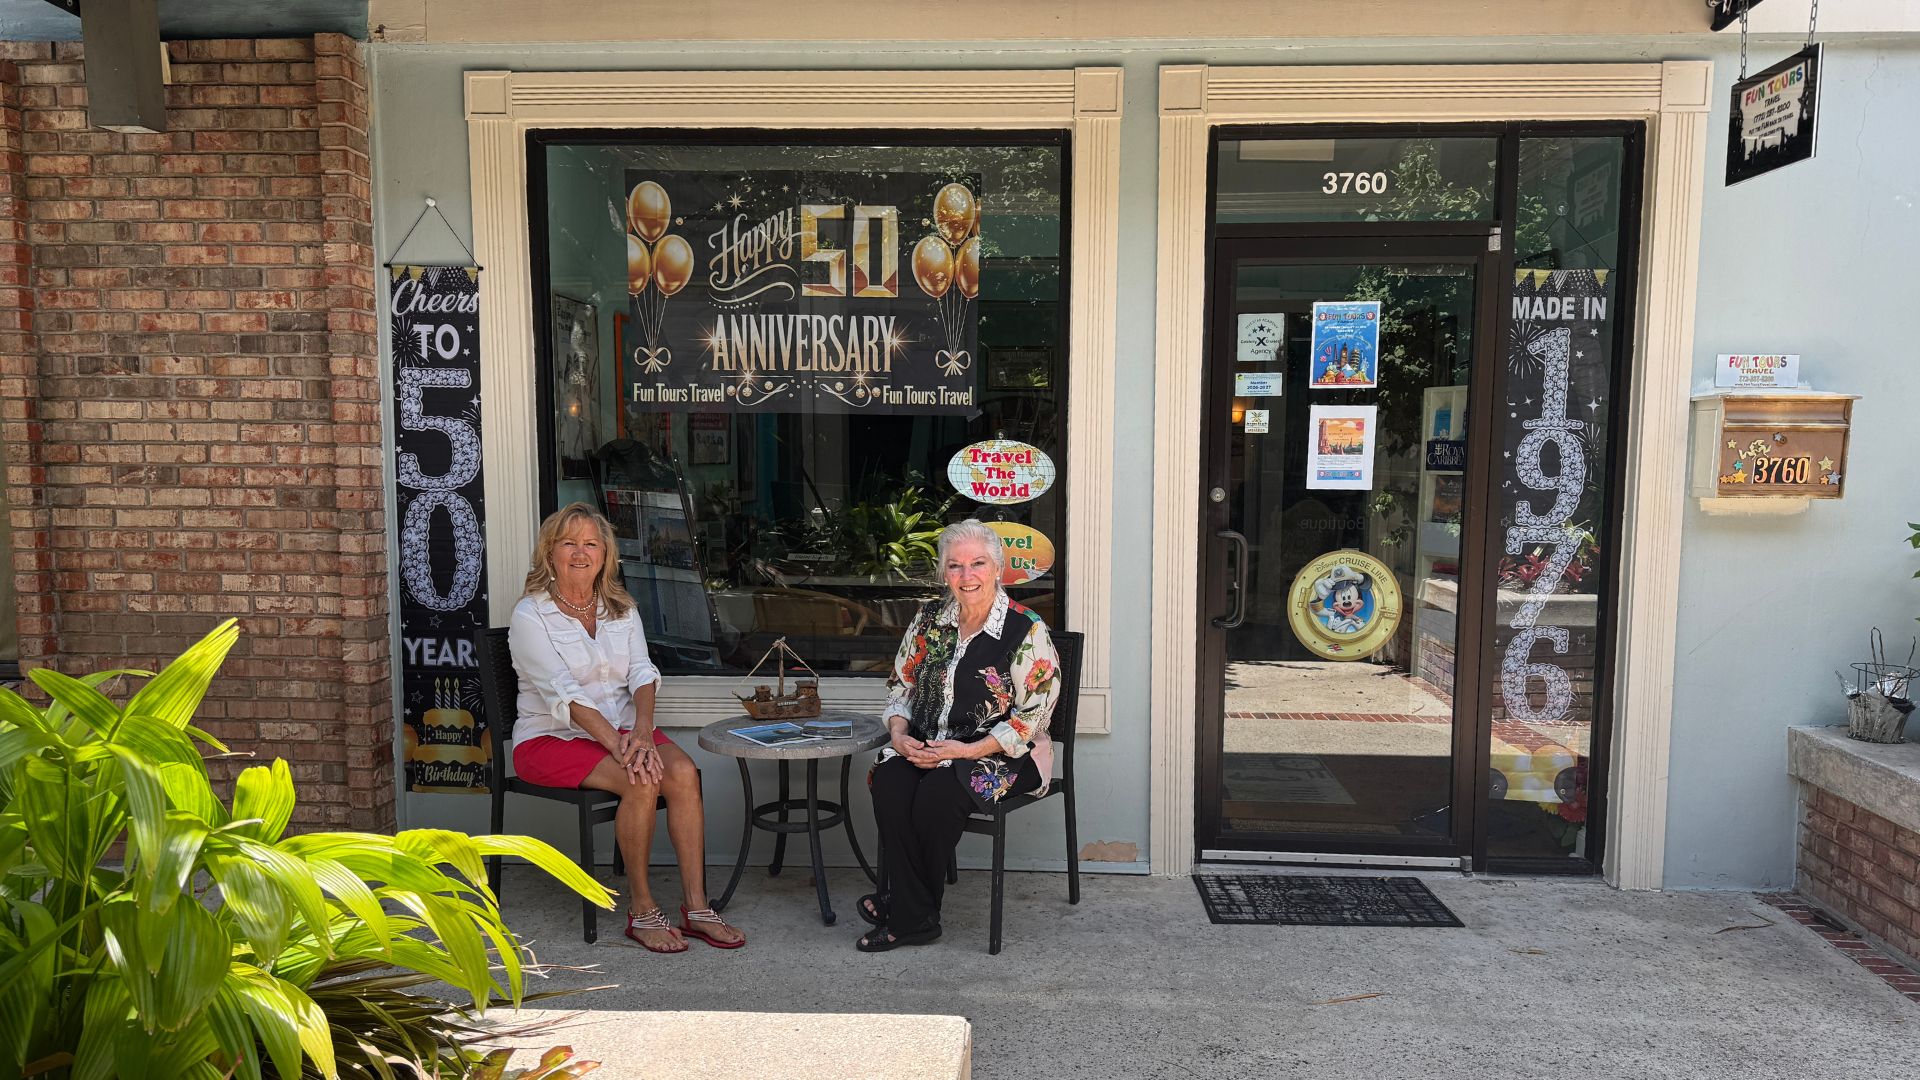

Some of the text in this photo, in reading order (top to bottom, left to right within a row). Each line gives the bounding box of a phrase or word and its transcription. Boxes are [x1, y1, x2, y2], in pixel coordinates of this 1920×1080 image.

[1745, 66, 1803, 106] FUN TOURS
[1764, 94, 1781, 108] TRAVEL
[1322, 171, 1388, 195] 3760
[708, 204, 899, 298] Happy 50
[391, 278, 479, 317] Cheers
[1512, 296, 1607, 320] MADE IN
[413, 323, 460, 361] TO
[712, 314, 897, 373] ANNIVERSARY
[1729, 355, 1788, 369] FUN TOURS
[633, 382, 725, 403] Fun Tours Travel
[882, 386, 973, 406] Fun Tours Travel
[968, 448, 1033, 464] Travel
[984, 467, 1016, 480] The
[1754, 457, 1810, 484] 3760
[971, 482, 1030, 497] World
[1501, 327, 1587, 722] 1976
[1010, 557, 1036, 570] Us!
[1339, 557, 1371, 570] CRUISE
[1371, 566, 1388, 584] LINE
[434, 729, 463, 743] Happy
[424, 765, 476, 788] Birthday
